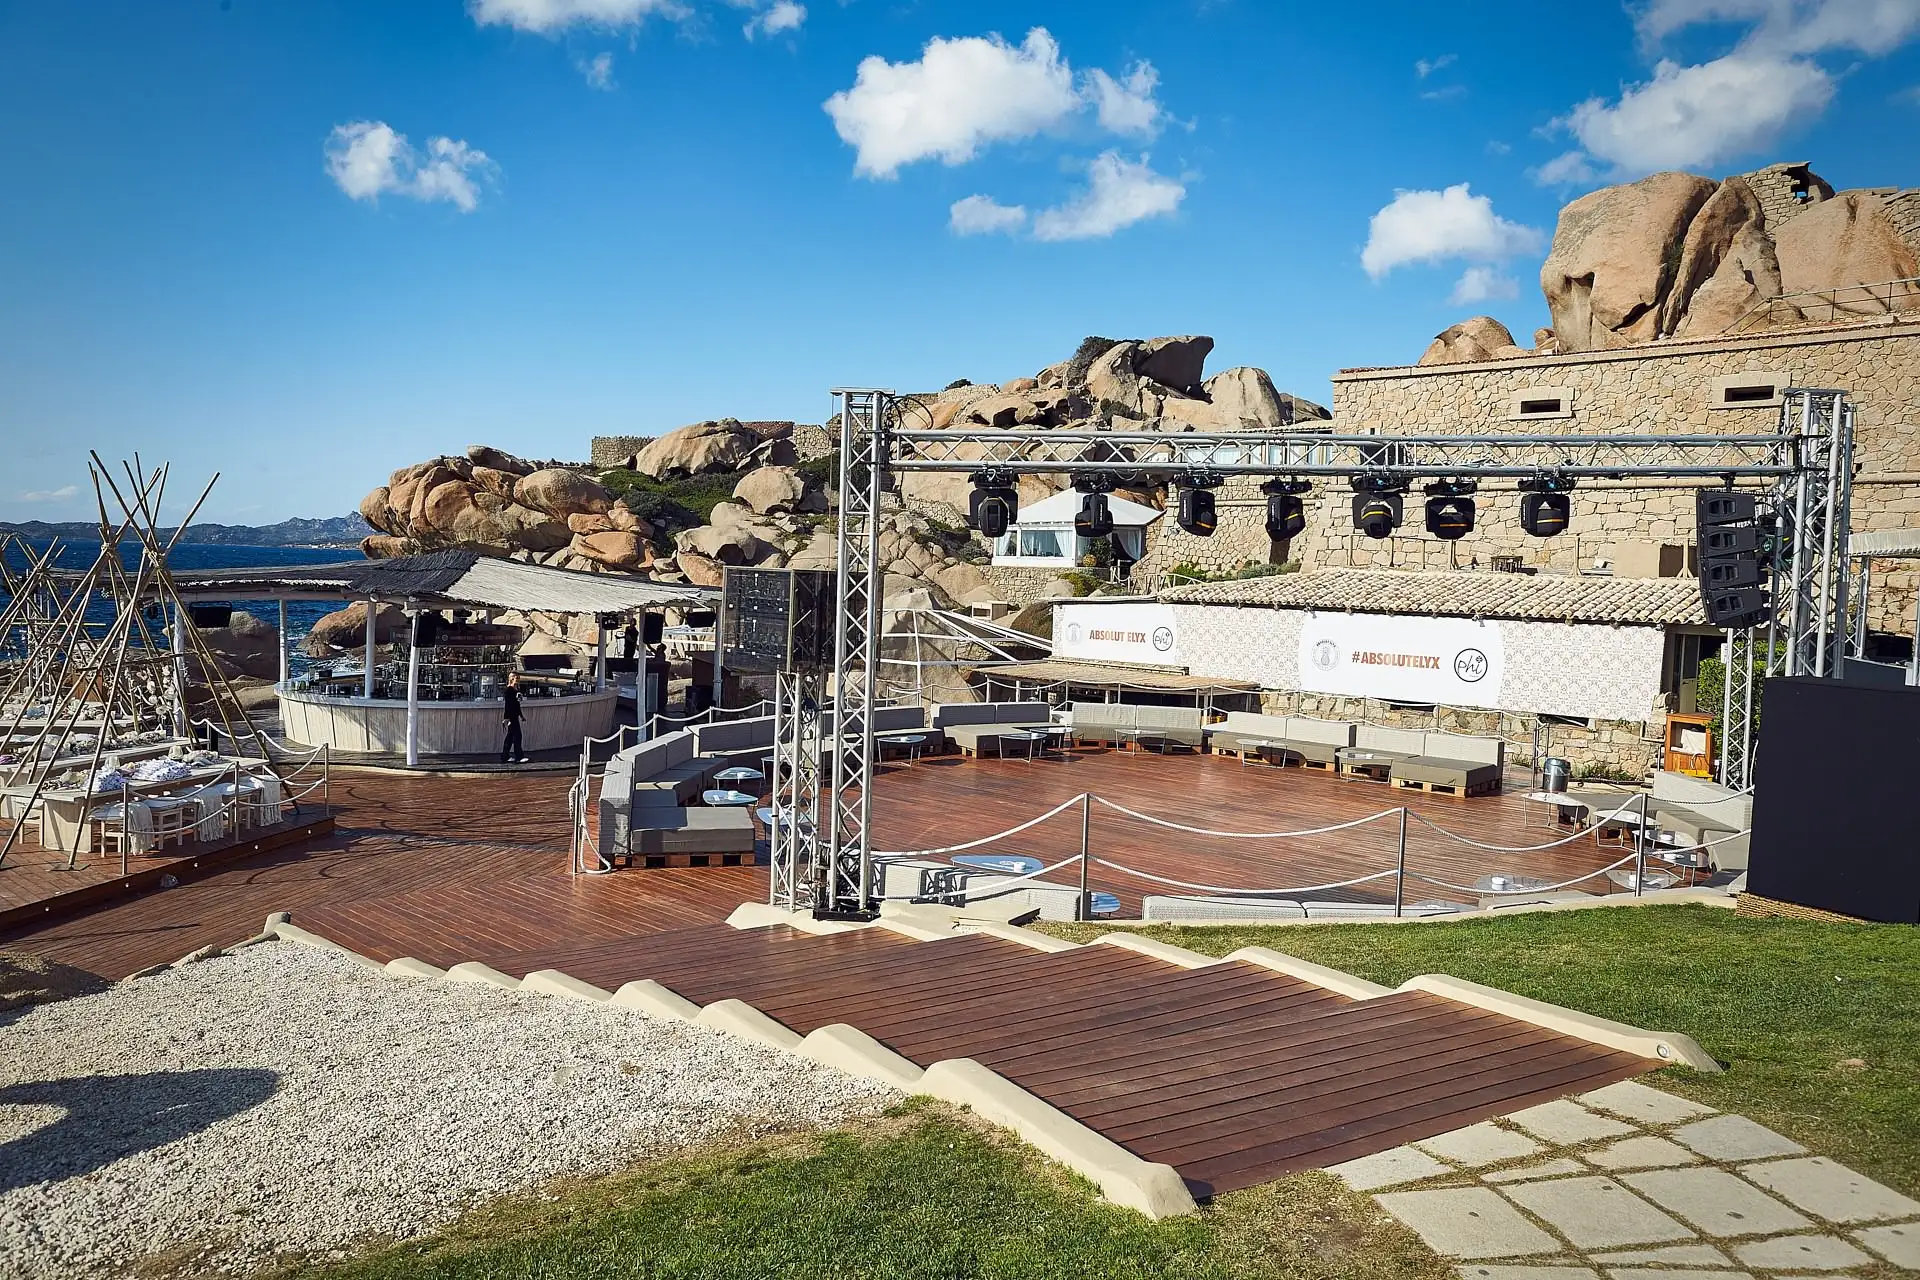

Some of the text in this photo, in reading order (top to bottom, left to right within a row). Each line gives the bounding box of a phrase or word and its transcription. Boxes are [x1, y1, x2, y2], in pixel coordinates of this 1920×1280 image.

[1089, 630, 1146, 643] ABSOLUT ELYX
[1352, 651, 1440, 669] #ABSOLUTELYX
